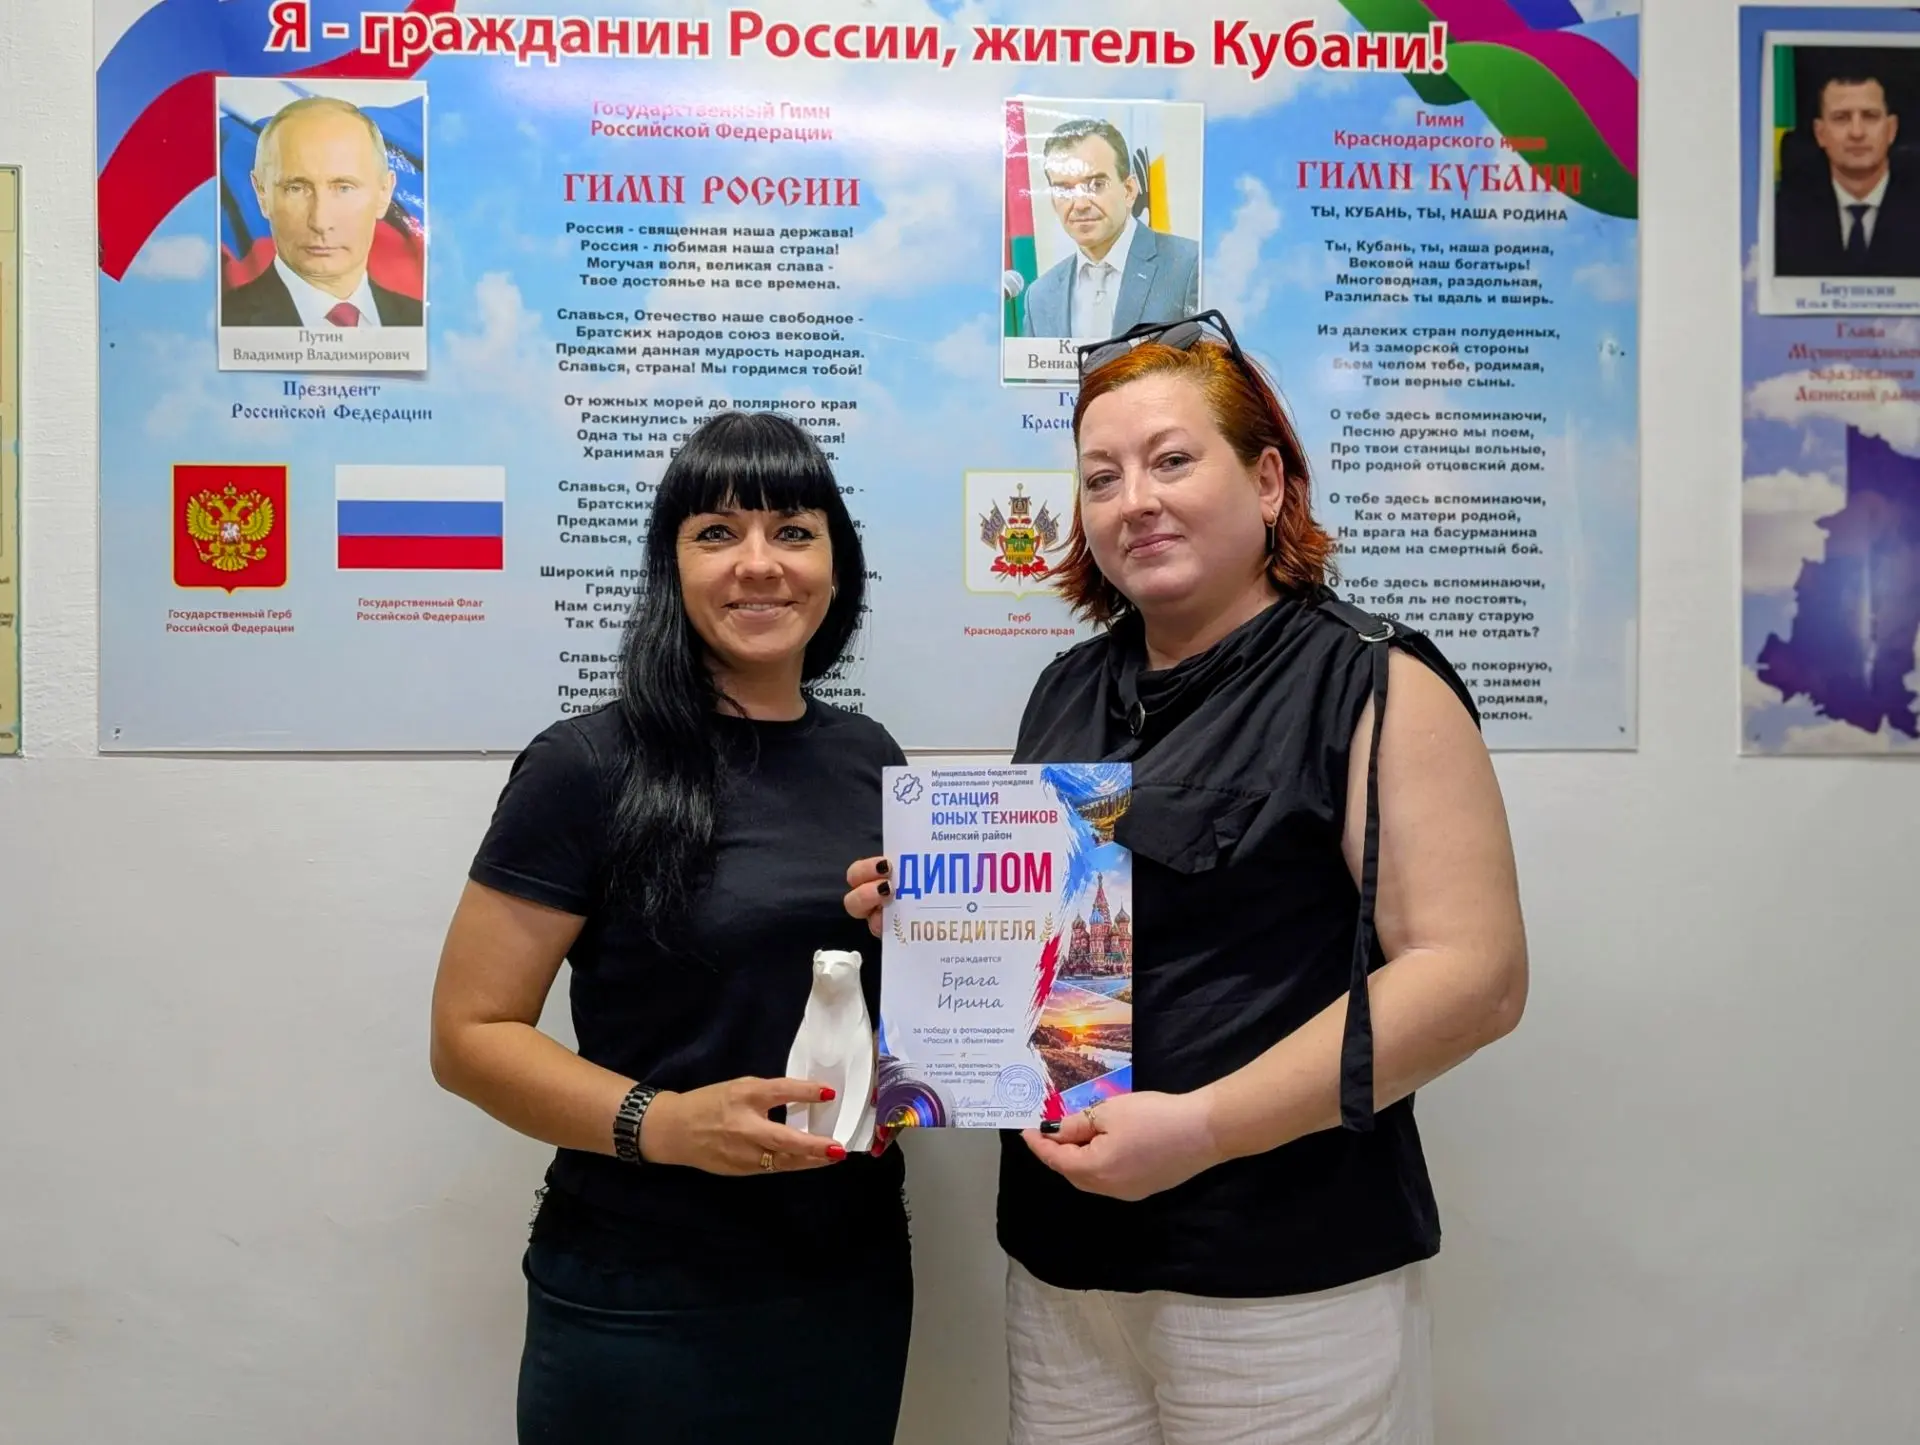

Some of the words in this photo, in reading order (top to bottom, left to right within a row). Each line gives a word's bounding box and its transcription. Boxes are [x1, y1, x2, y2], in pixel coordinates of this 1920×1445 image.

[270, 2, 306, 49] Я
[363, 14, 710, 65] гражданин
[729, 10, 959, 68] России,
[972, 25, 1196, 64] житель
[1212, 18, 1447, 80] Кубани!
[593, 102, 774, 119] Государственный
[780, 102, 829, 117] Гимн
[1416, 112, 1464, 126] Гимн
[591, 121, 710, 138] Российской
[715, 123, 832, 142] Федерации
[1334, 130, 1494, 148] Краснодарского
[1297, 162, 1414, 189] ГИМН
[1428, 164, 1581, 200] КУБАНИ
[563, 173, 685, 203] ГИМН
[702, 176, 861, 206] РОССИИ
[1310, 206, 1339, 219] ТЫ,
[1345, 206, 1411, 220] КУБАНЬ,
[1416, 207, 1445, 220] ТЫ,
[1450, 207, 1497, 219] НАША
[1503, 209, 1568, 222] РОДИНА
[566, 222, 623, 234] Россия
[639, 226, 728, 237] священная
[733, 227, 774, 236] наша
[780, 225, 854, 238] держава!
[580, 239, 638, 251] Россия
[653, 238, 726, 253] любимая
[732, 244, 774, 254] наша
[780, 242, 838, 257] страна!
[1324, 239, 1351, 253] Ты,
[1356, 239, 1415, 254] Кубань,
[1420, 244, 1443, 254] ты,
[1449, 244, 1489, 252] наша
[1494, 244, 1553, 256] родина,
[1349, 257, 1414, 269] Вековой
[1419, 260, 1450, 269] наш
[1454, 257, 1530, 272] богатырь!
[1336, 274, 1442, 287] Многоводная,
[1447, 278, 1542, 290] раздольная,
[1325, 290, 1409, 302] Разлилась
[1412, 293, 1432, 303] ты
[1438, 294, 1482, 304] вдаль
[1487, 294, 1496, 303] и
[1501, 295, 1553, 307] вширь.
[557, 308, 628, 323] Славься,
[634, 308, 716, 322] Отечество
[722, 313, 764, 322] наше
[769, 311, 853, 325] свободное
[299, 330, 342, 345] Путин
[577, 326, 651, 340] Братских
[657, 330, 723, 341] народов
[728, 330, 770, 340] союз
[776, 329, 844, 341] вековой.
[1317, 324, 1337, 335] Из
[1342, 327, 1407, 337] далеких
[1412, 327, 1456, 338] стран
[1461, 328, 1560, 340] полуденных,
[233, 348, 303, 363] Владимир
[307, 348, 409, 363] Владимирович
[556, 342, 636, 357] Предками
[641, 346, 699, 357] данная
[705, 348, 779, 359] мудрость
[784, 348, 864, 360] народная.
[558, 360, 629, 374] Славься,
[635, 361, 695, 375] страна!
[701, 362, 726, 373] Мы
[732, 365, 807, 376] гордимся
[812, 363, 861, 375] тобой!
[283, 382, 380, 400] Президент
[231, 403, 325, 419] Российской
[333, 404, 431, 422] Федерации
[581, 412, 687, 427] Раскинулись
[1330, 408, 1340, 419] О
[1346, 408, 1380, 420] тебе
[1386, 411, 1430, 421] здесь
[1435, 411, 1546, 422] вспоминаючи,
[799, 416, 840, 427] поля.
[577, 429, 617, 442] Одна
[622, 432, 642, 440] ты
[648, 432, 667, 441] на
[1342, 425, 1395, 436] Песню
[1399, 428, 1458, 439] дружно
[1463, 428, 1486, 436] мы
[1491, 428, 1534, 439] поем,
[583, 446, 663, 460] Хранимая
[1330, 442, 1359, 456] Про
[1364, 444, 1398, 453] твои
[1404, 445, 1469, 455] станицы
[1475, 445, 1545, 456] вольные,
[1331, 459, 1360, 473] Про
[1366, 458, 1421, 472] родной
[1426, 460, 1505, 471] отцовский
[1510, 462, 1544, 472] дом.
[558, 480, 630, 494] Славься,
[557, 514, 638, 528] Предками
[560, 532, 631, 545] Славься,
[1338, 527, 1357, 537] На
[1363, 528, 1405, 539] врага
[1410, 528, 1428, 537] на
[1433, 526, 1536, 540] басурманина
[1332, 544, 1356, 554] Мы
[1361, 545, 1400, 555] идем
[1406, 545, 1423, 553] на
[1428, 543, 1506, 556] смертный
[1511, 542, 1542, 554] бой.
[540, 565, 614, 580] Широкий
[358, 598, 454, 608] Государственный
[456, 598, 483, 607] Флаг
[554, 600, 587, 611] Нам
[593, 602, 631, 613] силу
[168, 609, 264, 620] Государственный
[267, 609, 292, 620] Герб
[356, 611, 419, 620] Российской
[422, 612, 484, 622] Федерации
[1008, 612, 1031, 623] Герб
[166, 623, 229, 632] Российской
[231, 623, 294, 634] Федерации
[964, 626, 1048, 636] Краснодарского
[1050, 628, 1074, 636] края
[1472, 662, 1552, 673] покорную,
[1483, 678, 1540, 687] знамен
[1477, 695, 1547, 705] родимая,
[932, 792, 998, 807] СТАНЦИЯ
[932, 811, 977, 825] ЮНЫХ
[981, 810, 1057, 824] ТЕХНИКОВ
[931, 830, 979, 840] Абинский
[982, 830, 1011, 842] район
[896, 852, 1052, 899] ДИПЛОМ
[910, 920, 1036, 943] ПОБЕДИТЕЛЯ
[940, 955, 1002, 964] награждается
[942, 972, 999, 990] Брага
[938, 994, 1004, 1012] Ирина
